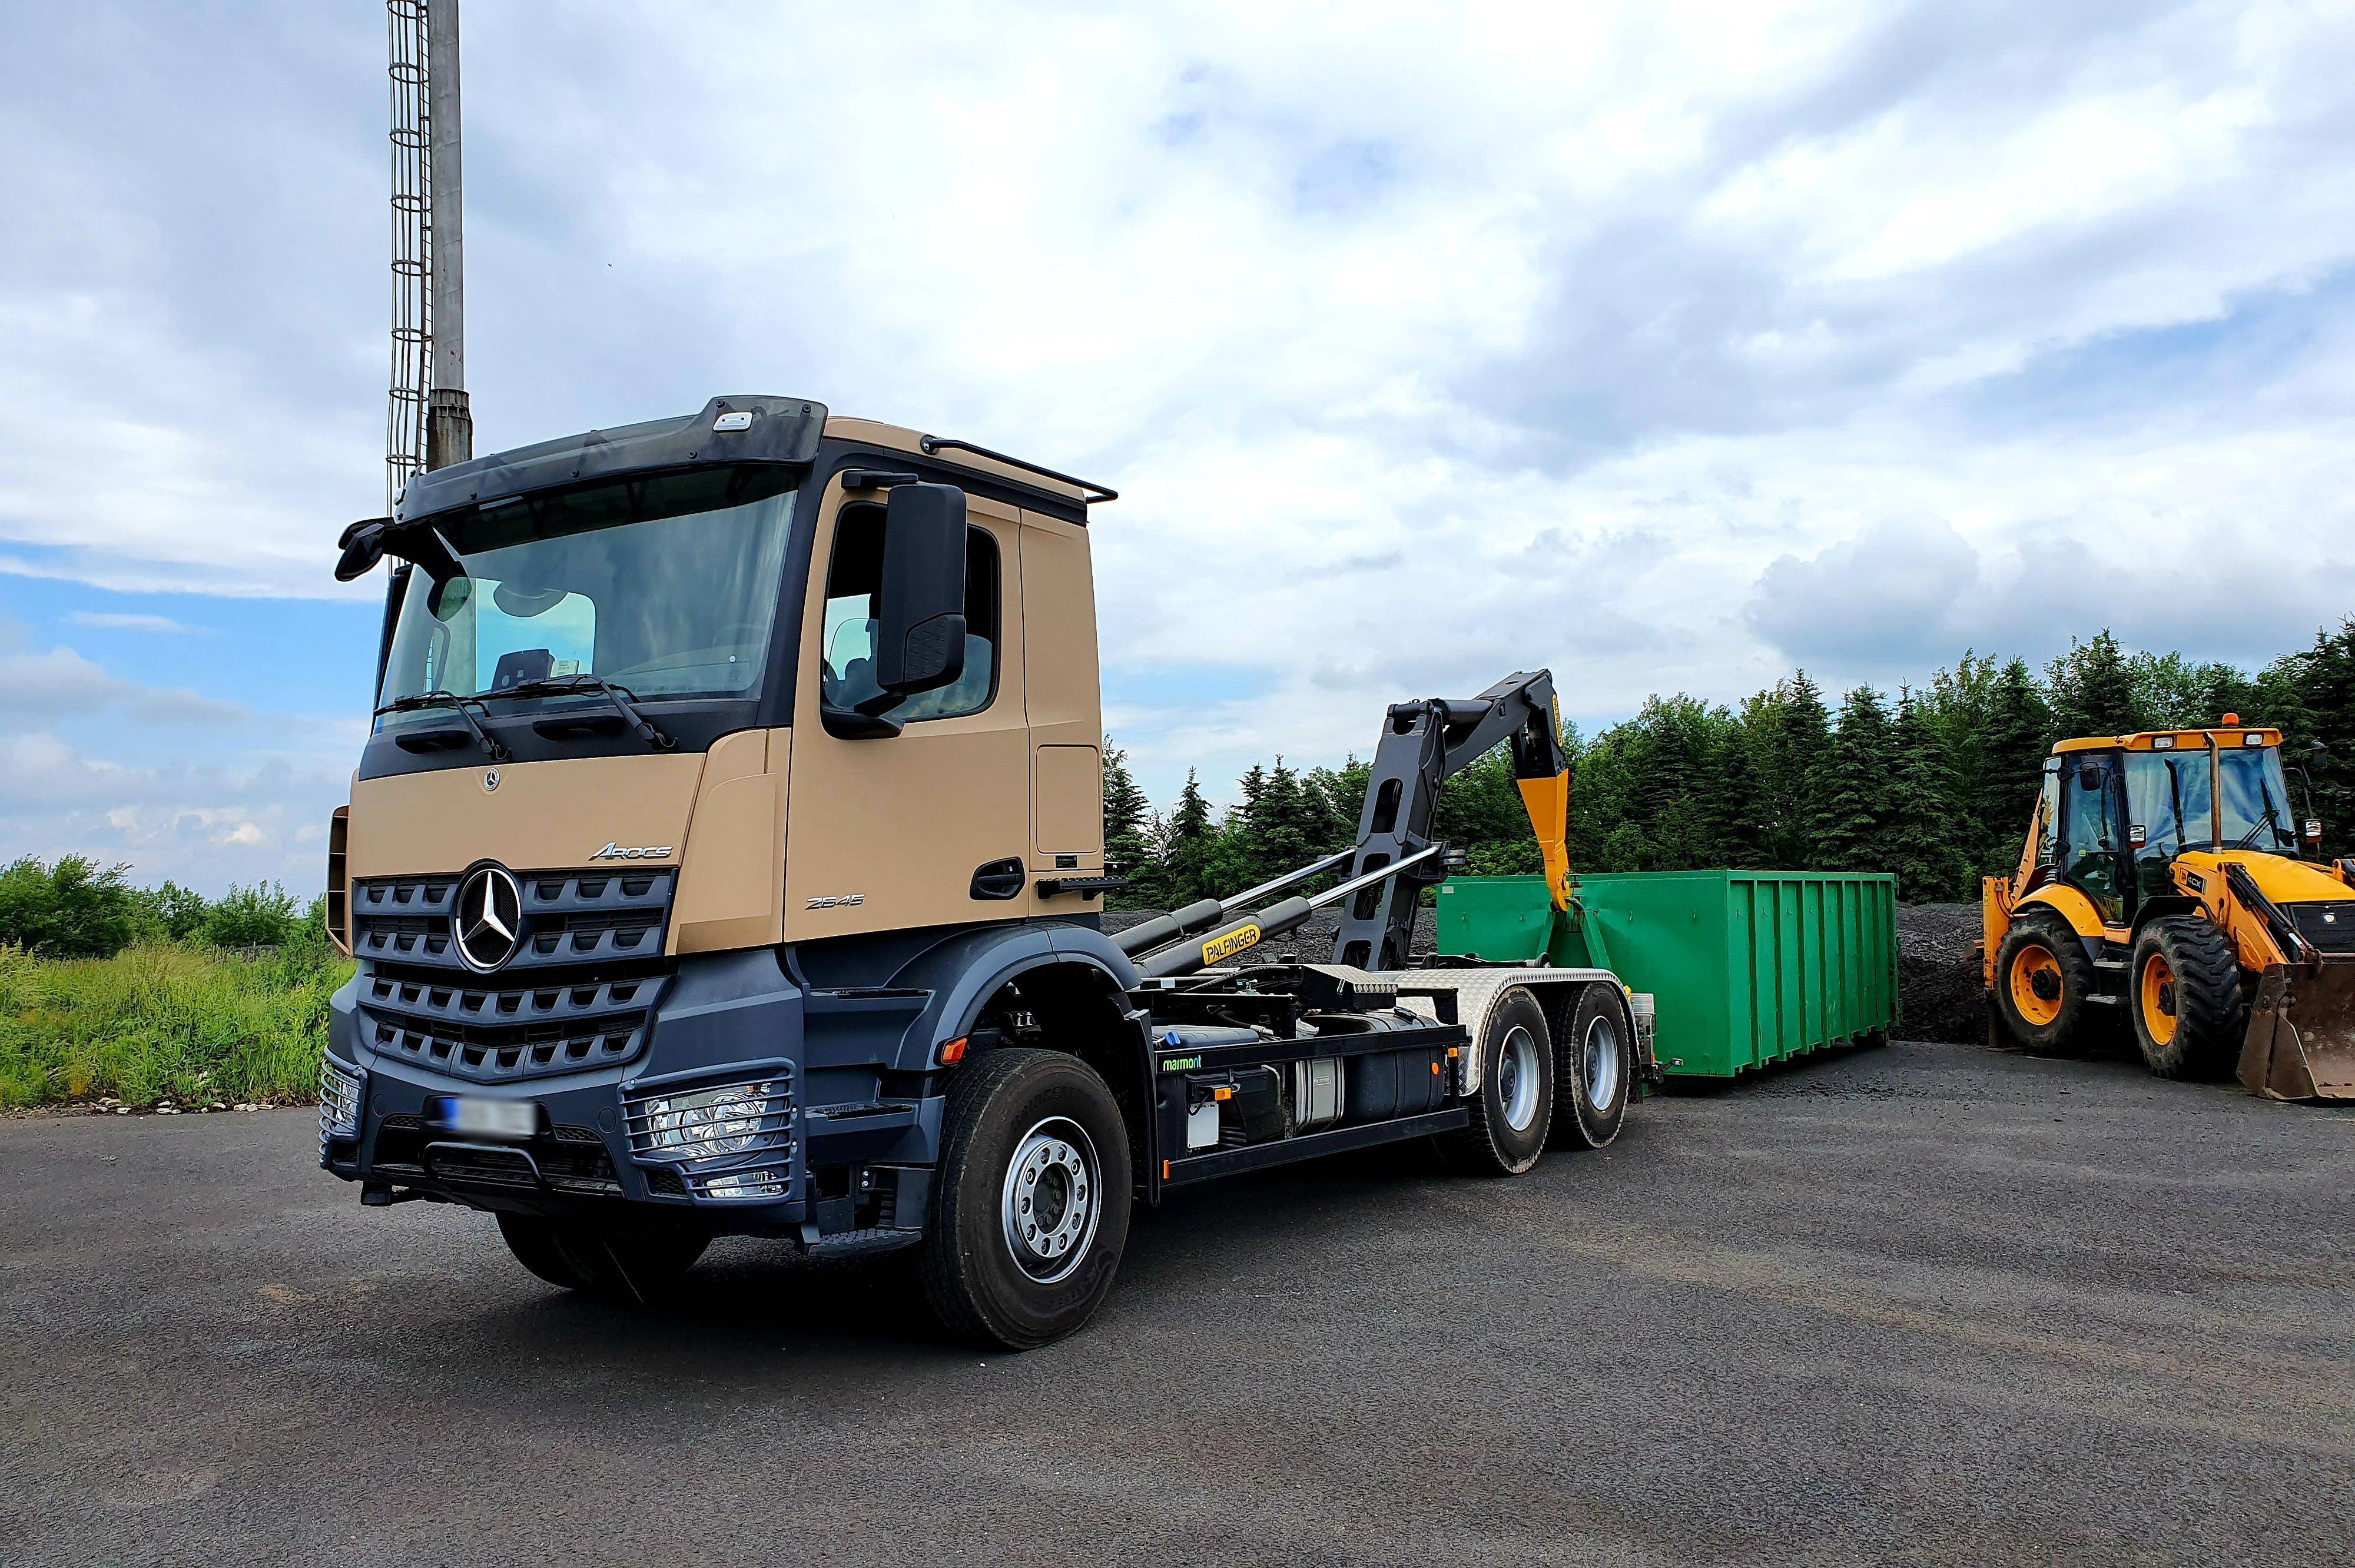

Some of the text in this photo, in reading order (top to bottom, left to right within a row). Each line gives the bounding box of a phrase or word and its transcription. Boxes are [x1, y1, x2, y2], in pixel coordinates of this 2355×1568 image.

[805, 893, 865, 910] 2545
[1206, 928, 1256, 962] PALFINGER
[1163, 1055, 1201, 1071] marmont
